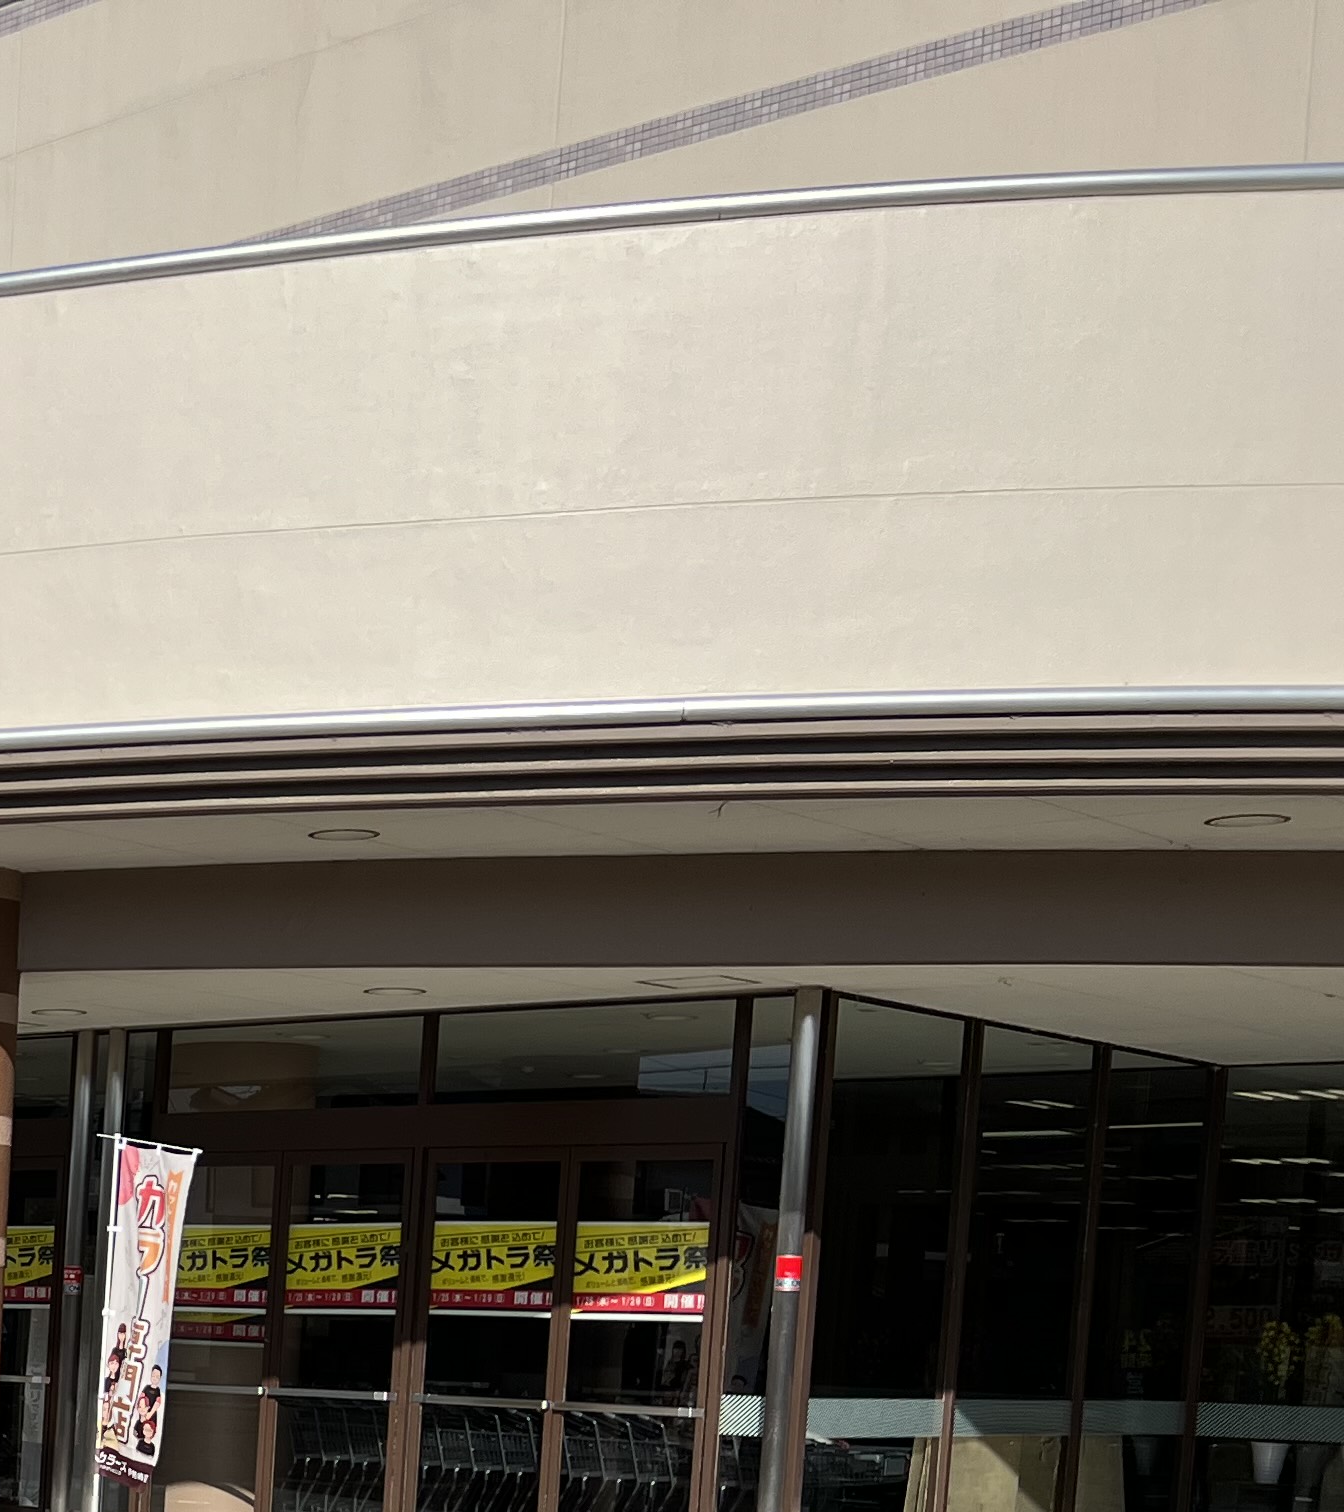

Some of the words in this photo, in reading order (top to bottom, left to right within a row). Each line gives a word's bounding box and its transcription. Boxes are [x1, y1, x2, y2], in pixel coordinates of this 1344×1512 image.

[286, 1245, 400, 1274] メガトラ祭
[432, 1245, 556, 1273] メガトラ祭
[573, 1246, 708, 1276] メガトラ祭
